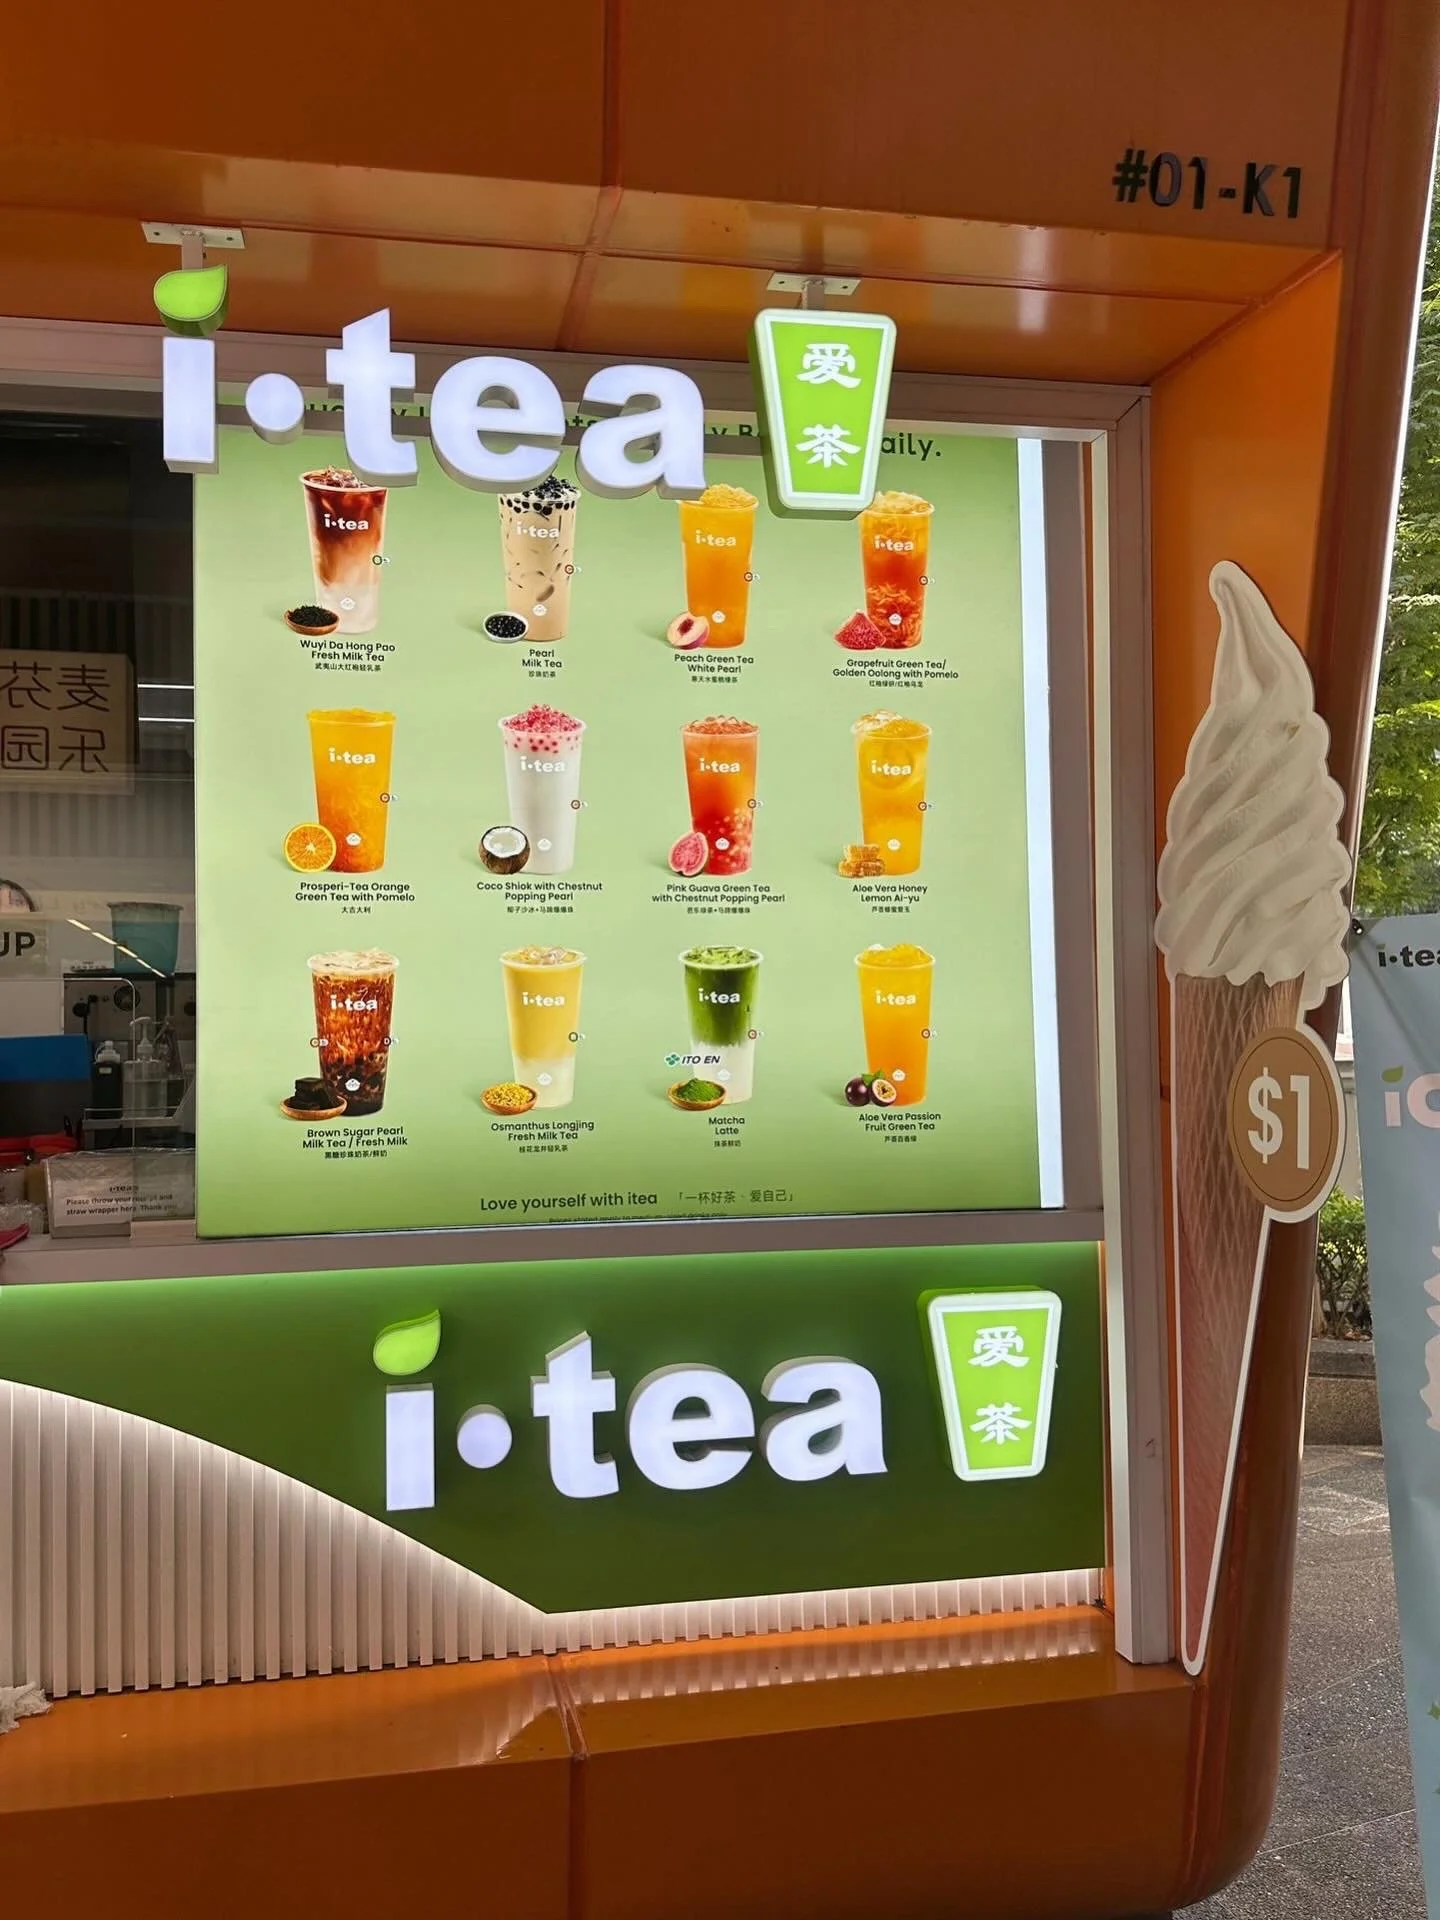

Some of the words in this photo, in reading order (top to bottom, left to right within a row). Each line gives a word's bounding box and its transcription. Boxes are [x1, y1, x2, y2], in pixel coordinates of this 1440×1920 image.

[1111, 148, 1302, 219] #01-K1
[797, 342, 862, 469] 爱茶
[881, 432, 941, 458] aily.
[300, 639, 327, 650] Wuyi
[329, 640, 344, 650] Da
[346, 641, 373, 653] Hong
[375, 643, 395, 652] Pao
[311, 650, 340, 661] Fresh
[342, 651, 364, 661] Milk
[366, 652, 385, 662] Tea
[529, 648, 555, 658] Pearl
[522, 658, 542, 668] Milk
[544, 659, 562, 668] Tea
[674, 654, 704, 664] Peach
[705, 654, 734, 664] Green
[736, 655, 754, 664] Tea
[846, 658, 894, 670] Grapefruit
[895, 659, 924, 669] Green
[925, 659, 947, 670] Tea/
[687, 664, 715, 673] White
[717, 665, 741, 674] Pearl
[833, 668, 866, 678] Golden
[868, 669, 901, 680] Oolong
[902, 669, 922, 678] with
[924, 670, 959, 680] Pomelo
[300, 881, 369, 893] Prosperi-Tea
[371, 882, 410, 893] Orange
[476, 881, 503, 891] Coco
[505, 881, 535, 891] Shiok
[537, 881, 555, 891] with
[557, 881, 602, 891] Chestnut
[666, 884, 687, 893] Pink
[688, 884, 721, 893] Guava
[722, 884, 751, 893] Green
[752, 885, 770, 893] Tea
[852, 884, 873, 893] Aloe
[874, 884, 897, 893] Vera
[898, 884, 928, 895] Honey
[295, 892, 327, 902] Green
[329, 892, 349, 902] Tea
[351, 892, 374, 901] with
[376, 892, 415, 902] Pomelo
[505, 891, 546, 902] Popping
[548, 891, 573, 901] Pearl
[651, 893, 673, 902] with
[674, 893, 718, 902] Chestnut
[720, 893, 759, 904] Popping
[761, 893, 785, 902] Pearl
[860, 893, 892, 902] Lemon
[341, 906, 372, 914] 大吉大利
[682, 1055, 701, 1064] ITO
[704, 1055, 721, 1064] EN
[708, 1116, 745, 1125] Matcha
[858, 1113, 880, 1122] Aloe
[881, 1112, 903, 1121] Vera
[905, 1111, 941, 1121] Passion
[1247, 1066, 1310, 1170] $1
[491, 1121, 550, 1132] Osmanthus
[552, 1119, 595, 1132] Longjing
[715, 1126, 740, 1136] Latte
[865, 1122, 886, 1132] Fruit
[887, 1122, 916, 1131] Green
[917, 1122, 935, 1131] Tea
[307, 1128, 341, 1138] Brown
[343, 1128, 375, 1139] Sugar
[377, 1126, 403, 1136] Pearl
[508, 1131, 536, 1141] Fresh
[537, 1131, 558, 1140] Milk
[560, 1130, 578, 1140] Tea
[302, 1138, 325, 1149] Milk
[326, 1138, 346, 1148] Tea
[356, 1136, 385, 1147] Fresh
[386, 1135, 408, 1146] Milk
[480, 1197, 518, 1211] Love
[521, 1193, 587, 1213] yourself
[590, 1192, 624, 1207] with
[627, 1192, 657, 1205] itea
[969, 1325, 1033, 1446] 爱茶
